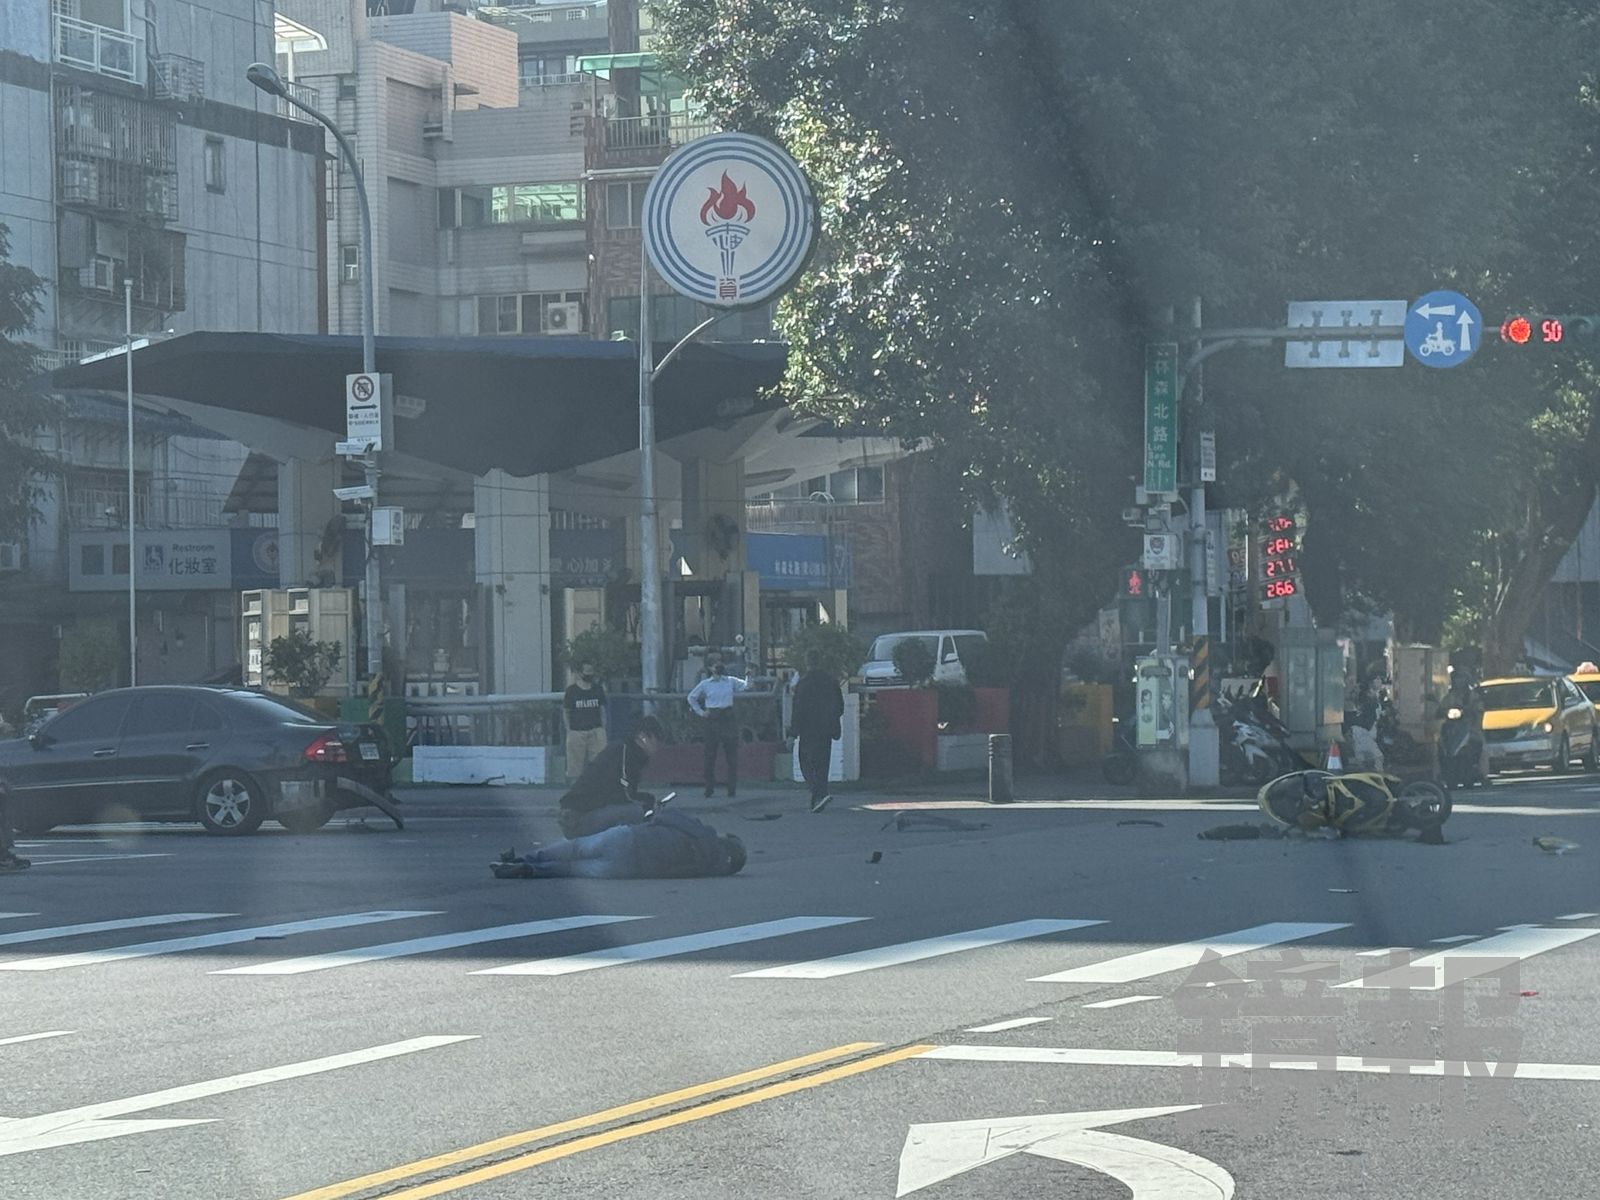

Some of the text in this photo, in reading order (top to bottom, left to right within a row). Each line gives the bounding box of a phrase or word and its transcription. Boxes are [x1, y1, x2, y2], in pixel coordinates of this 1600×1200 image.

[1541, 319, 1563, 342] 50
[1153, 359, 1170, 443] 林森北路
[172, 543, 215, 553] Restroom
